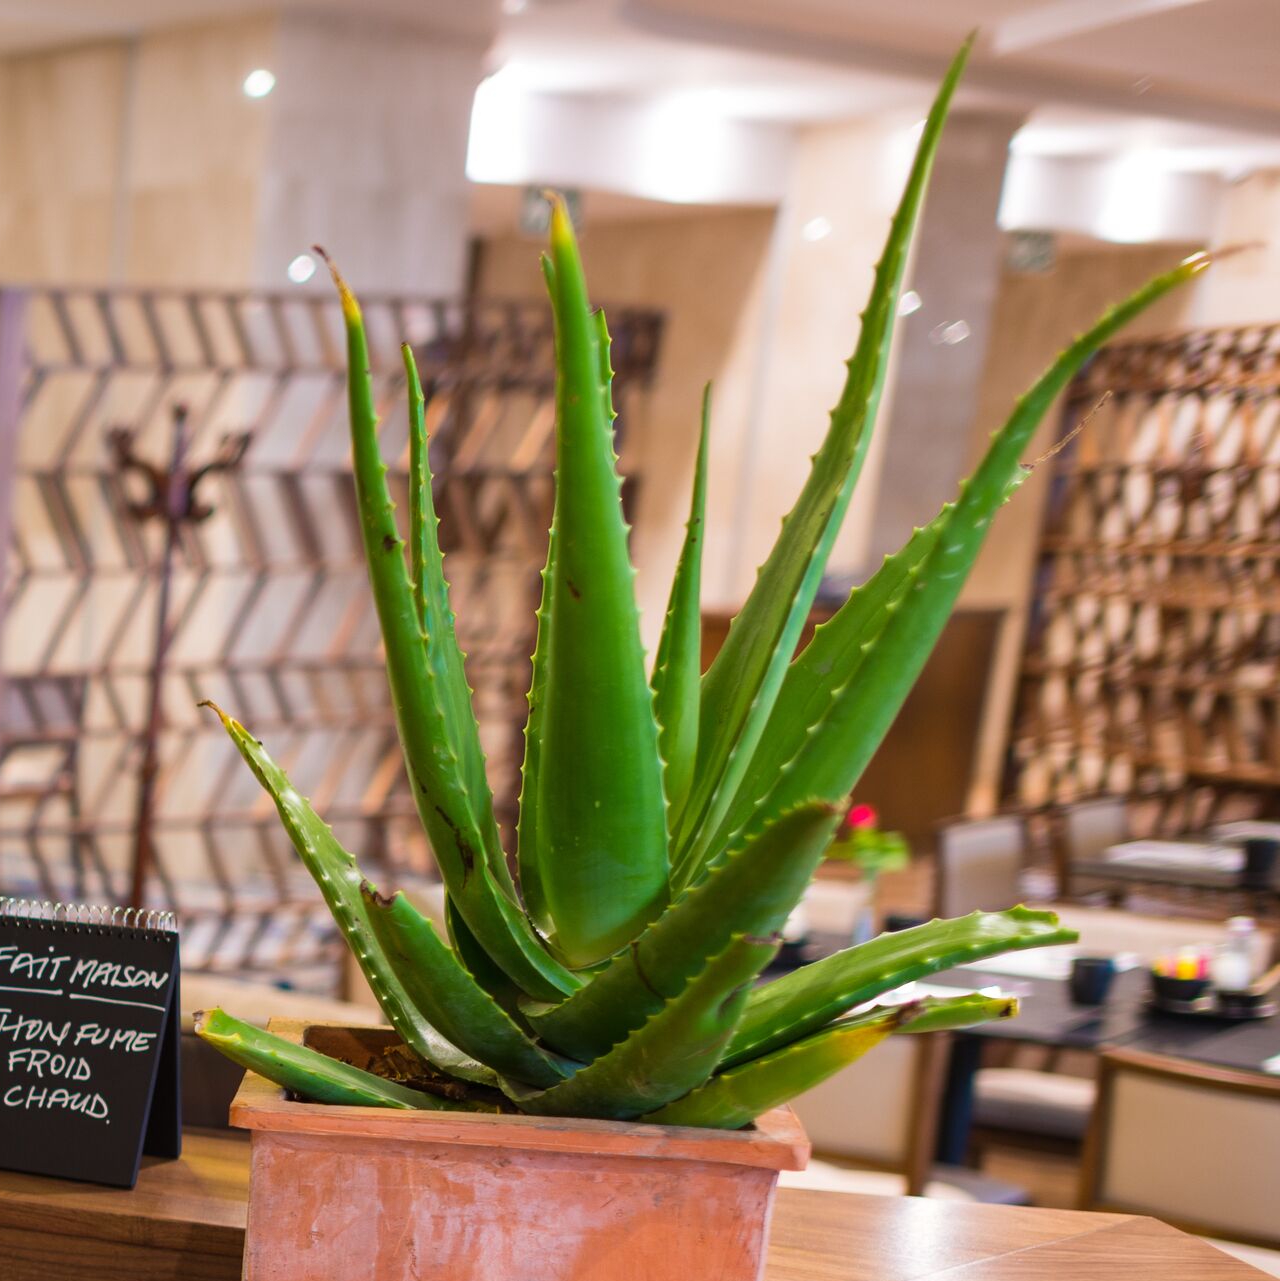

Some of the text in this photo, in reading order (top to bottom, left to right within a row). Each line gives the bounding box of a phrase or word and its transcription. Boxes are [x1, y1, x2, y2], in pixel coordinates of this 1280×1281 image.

[68, 957, 170, 990] MAISON
[73, 1022, 158, 1053] FUME
[7, 1048, 92, 1082] FROID
